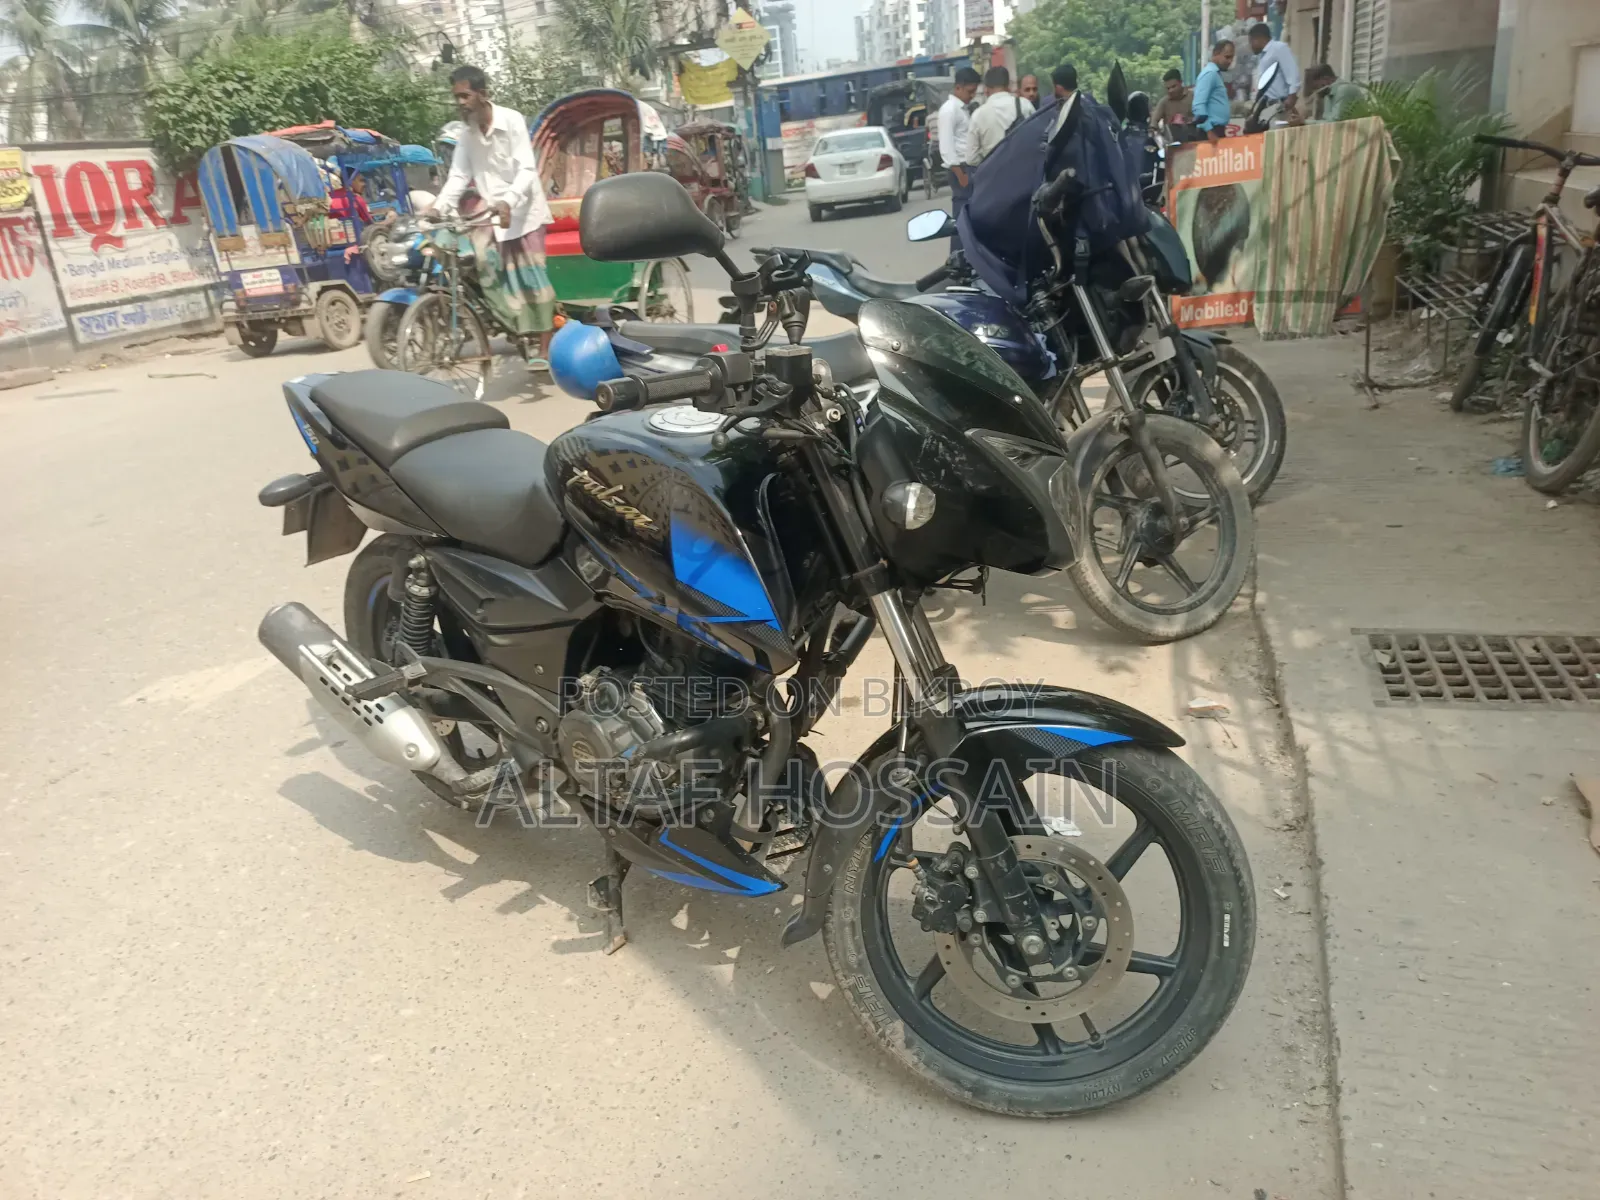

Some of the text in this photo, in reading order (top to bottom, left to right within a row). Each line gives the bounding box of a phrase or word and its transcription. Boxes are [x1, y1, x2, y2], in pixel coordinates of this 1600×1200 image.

[1180, 145, 1255, 180] smillah
[1181, 298, 1253, 322] Mobile:0
[1168, 799, 1227, 874] MRF
[1083, 1083, 1121, 1102] NYLON
